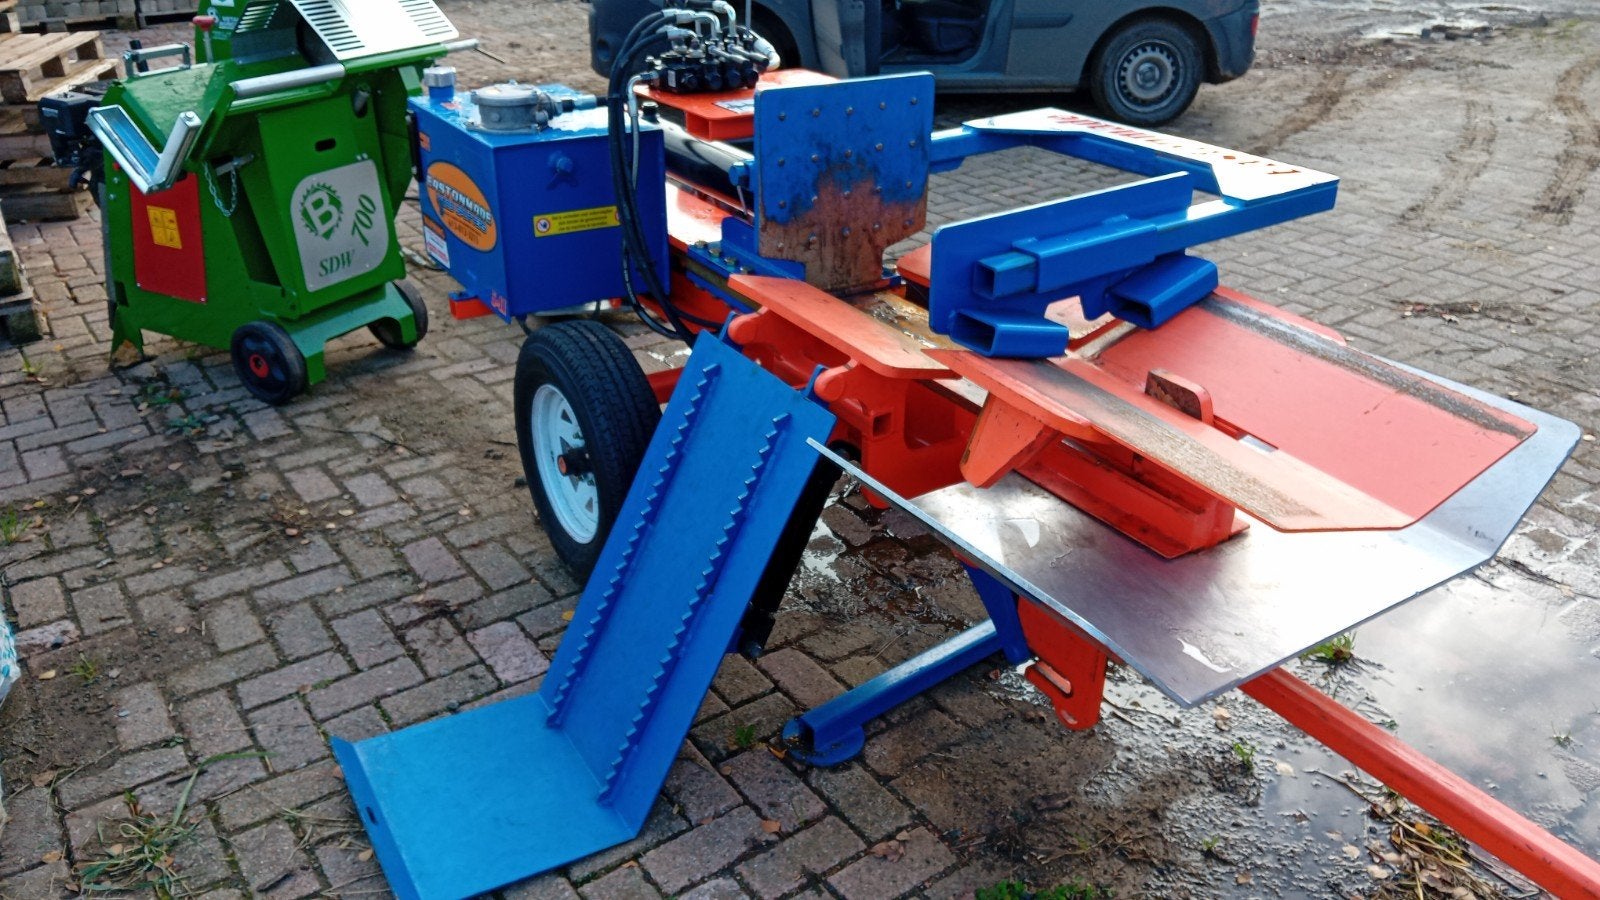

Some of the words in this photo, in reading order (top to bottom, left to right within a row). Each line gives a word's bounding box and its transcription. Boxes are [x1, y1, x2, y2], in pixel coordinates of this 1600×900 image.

[304, 190, 340, 237] B
[351, 194, 377, 247] 700
[318, 249, 356, 277] SDW
